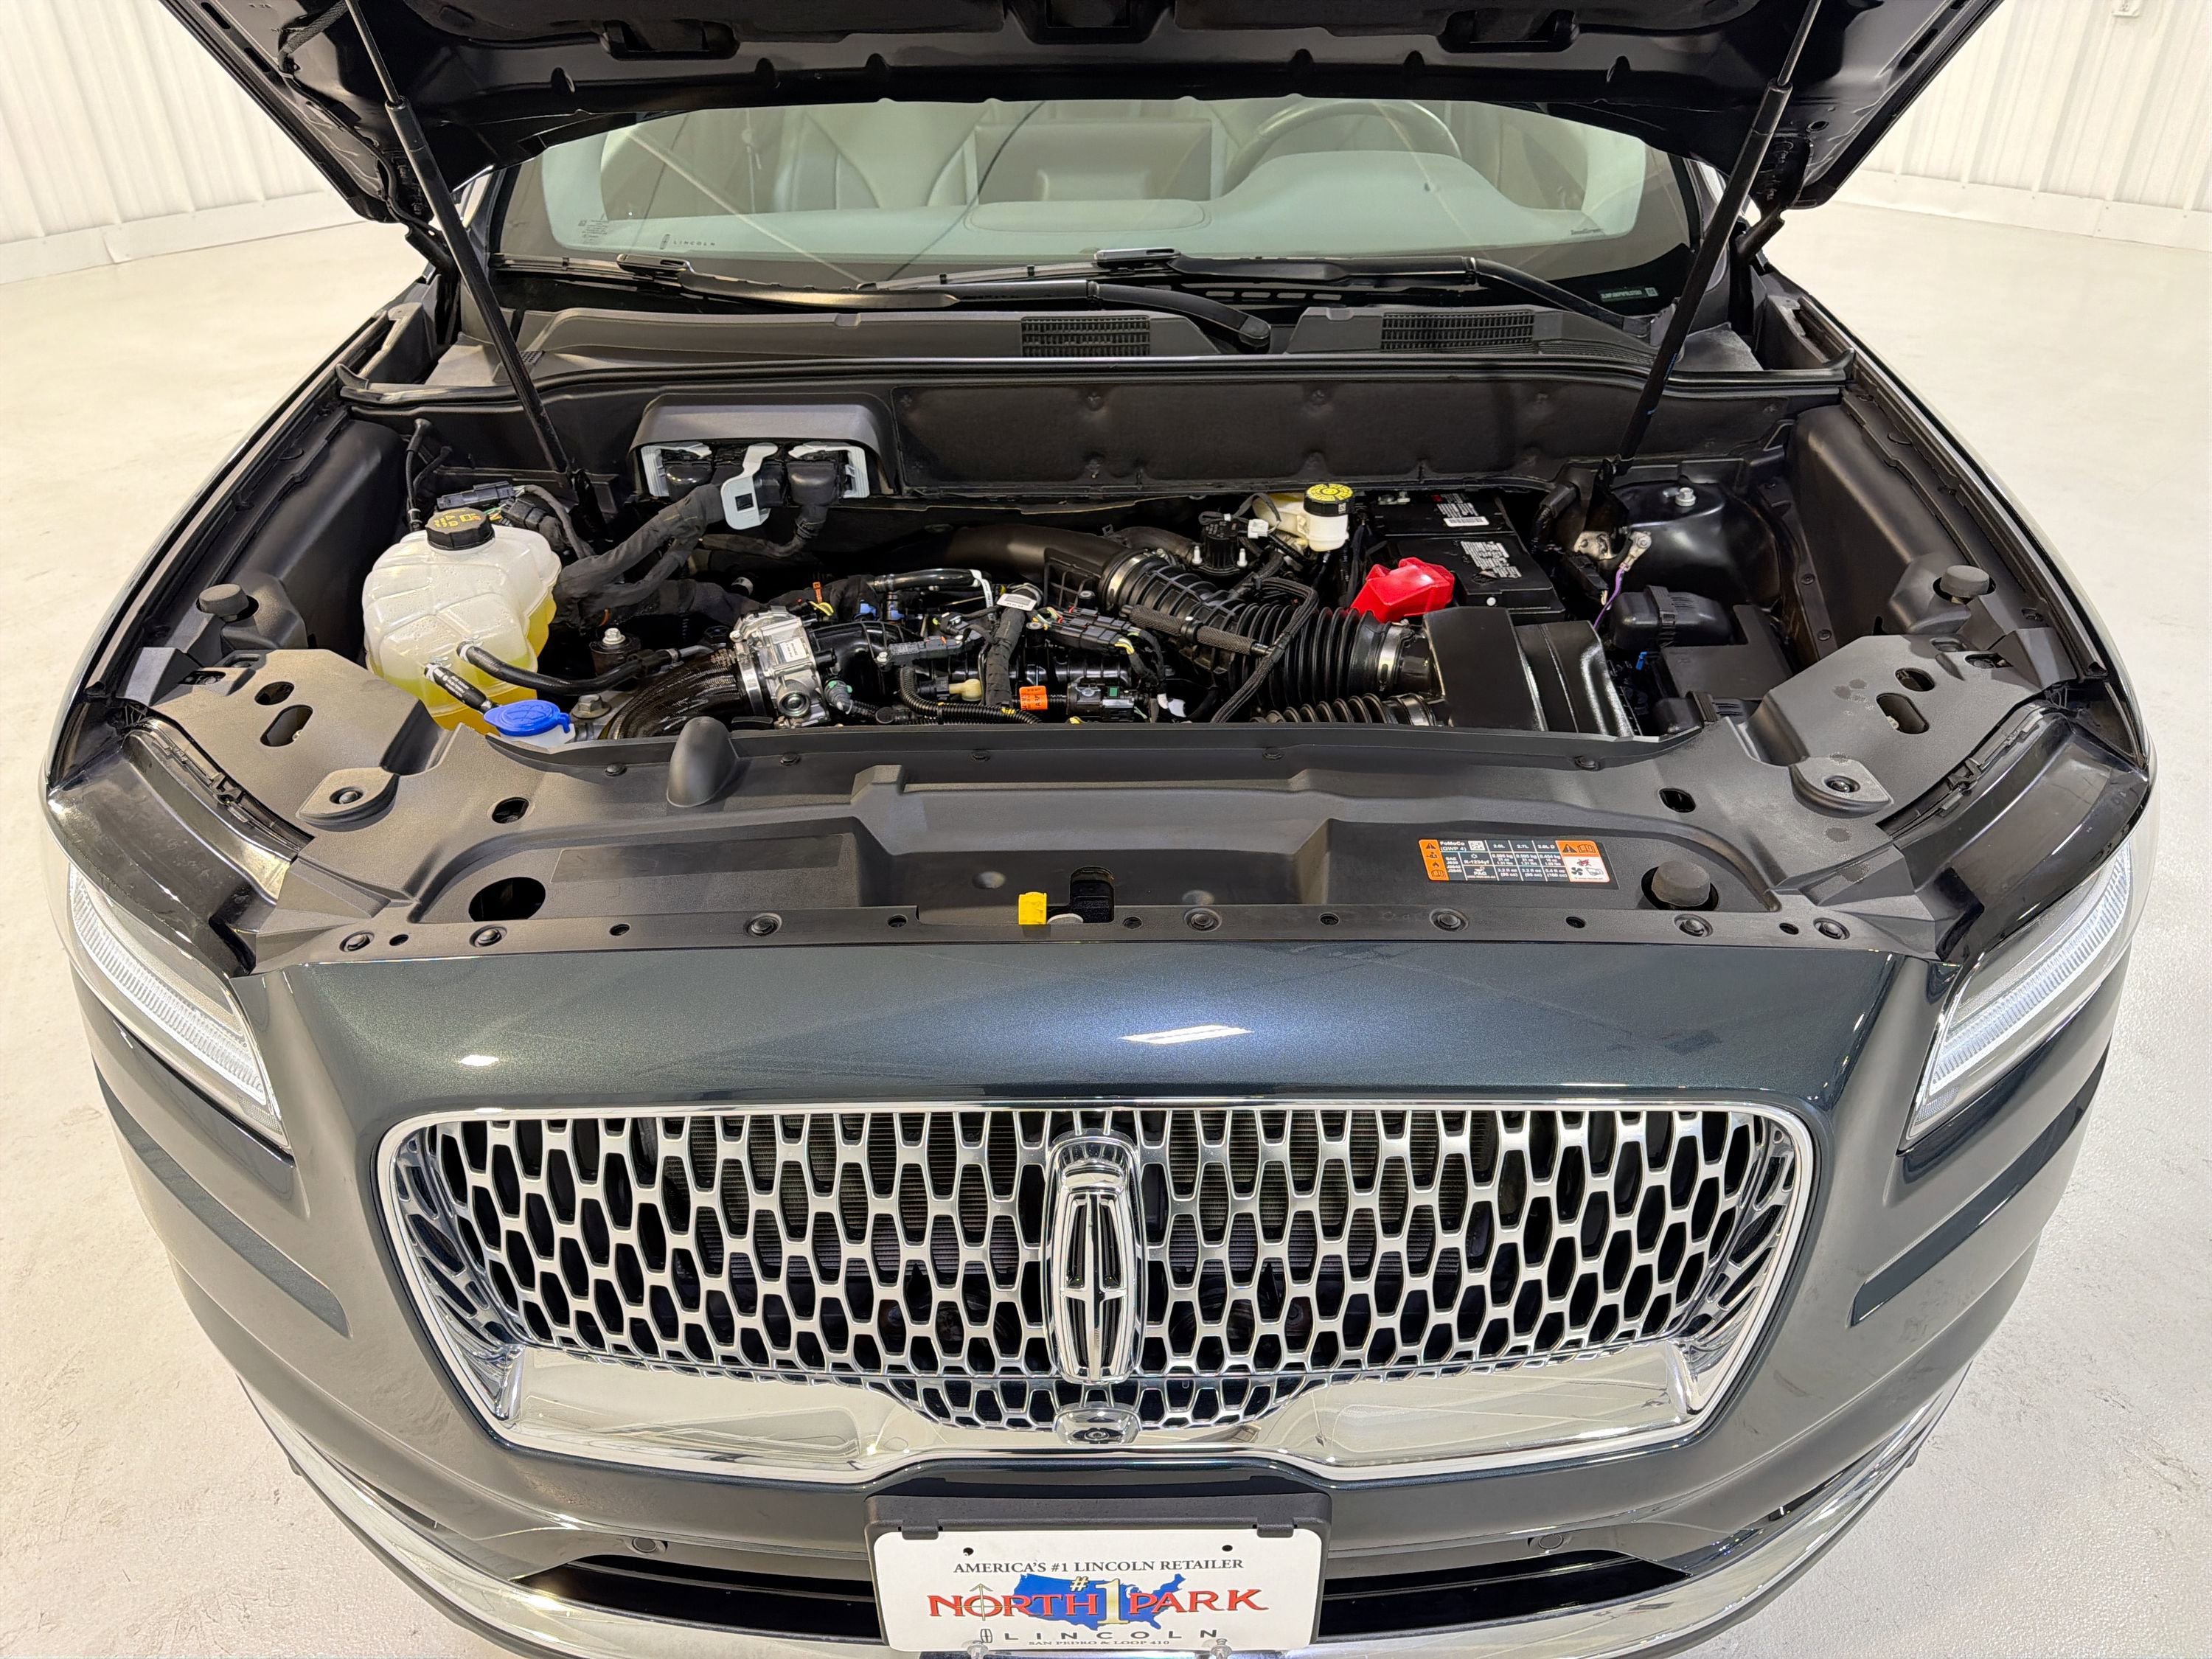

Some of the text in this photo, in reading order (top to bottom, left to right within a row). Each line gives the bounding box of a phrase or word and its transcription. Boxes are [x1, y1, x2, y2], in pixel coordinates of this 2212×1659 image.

[953, 1559, 1245, 1573] AMERICA’S #1 LINCOLN RETAILER
[927, 1593, 1099, 1618] NORTH
[1128, 1589, 1270, 1615] PARK
[1004, 1629, 1217, 1641] LINCOLN
